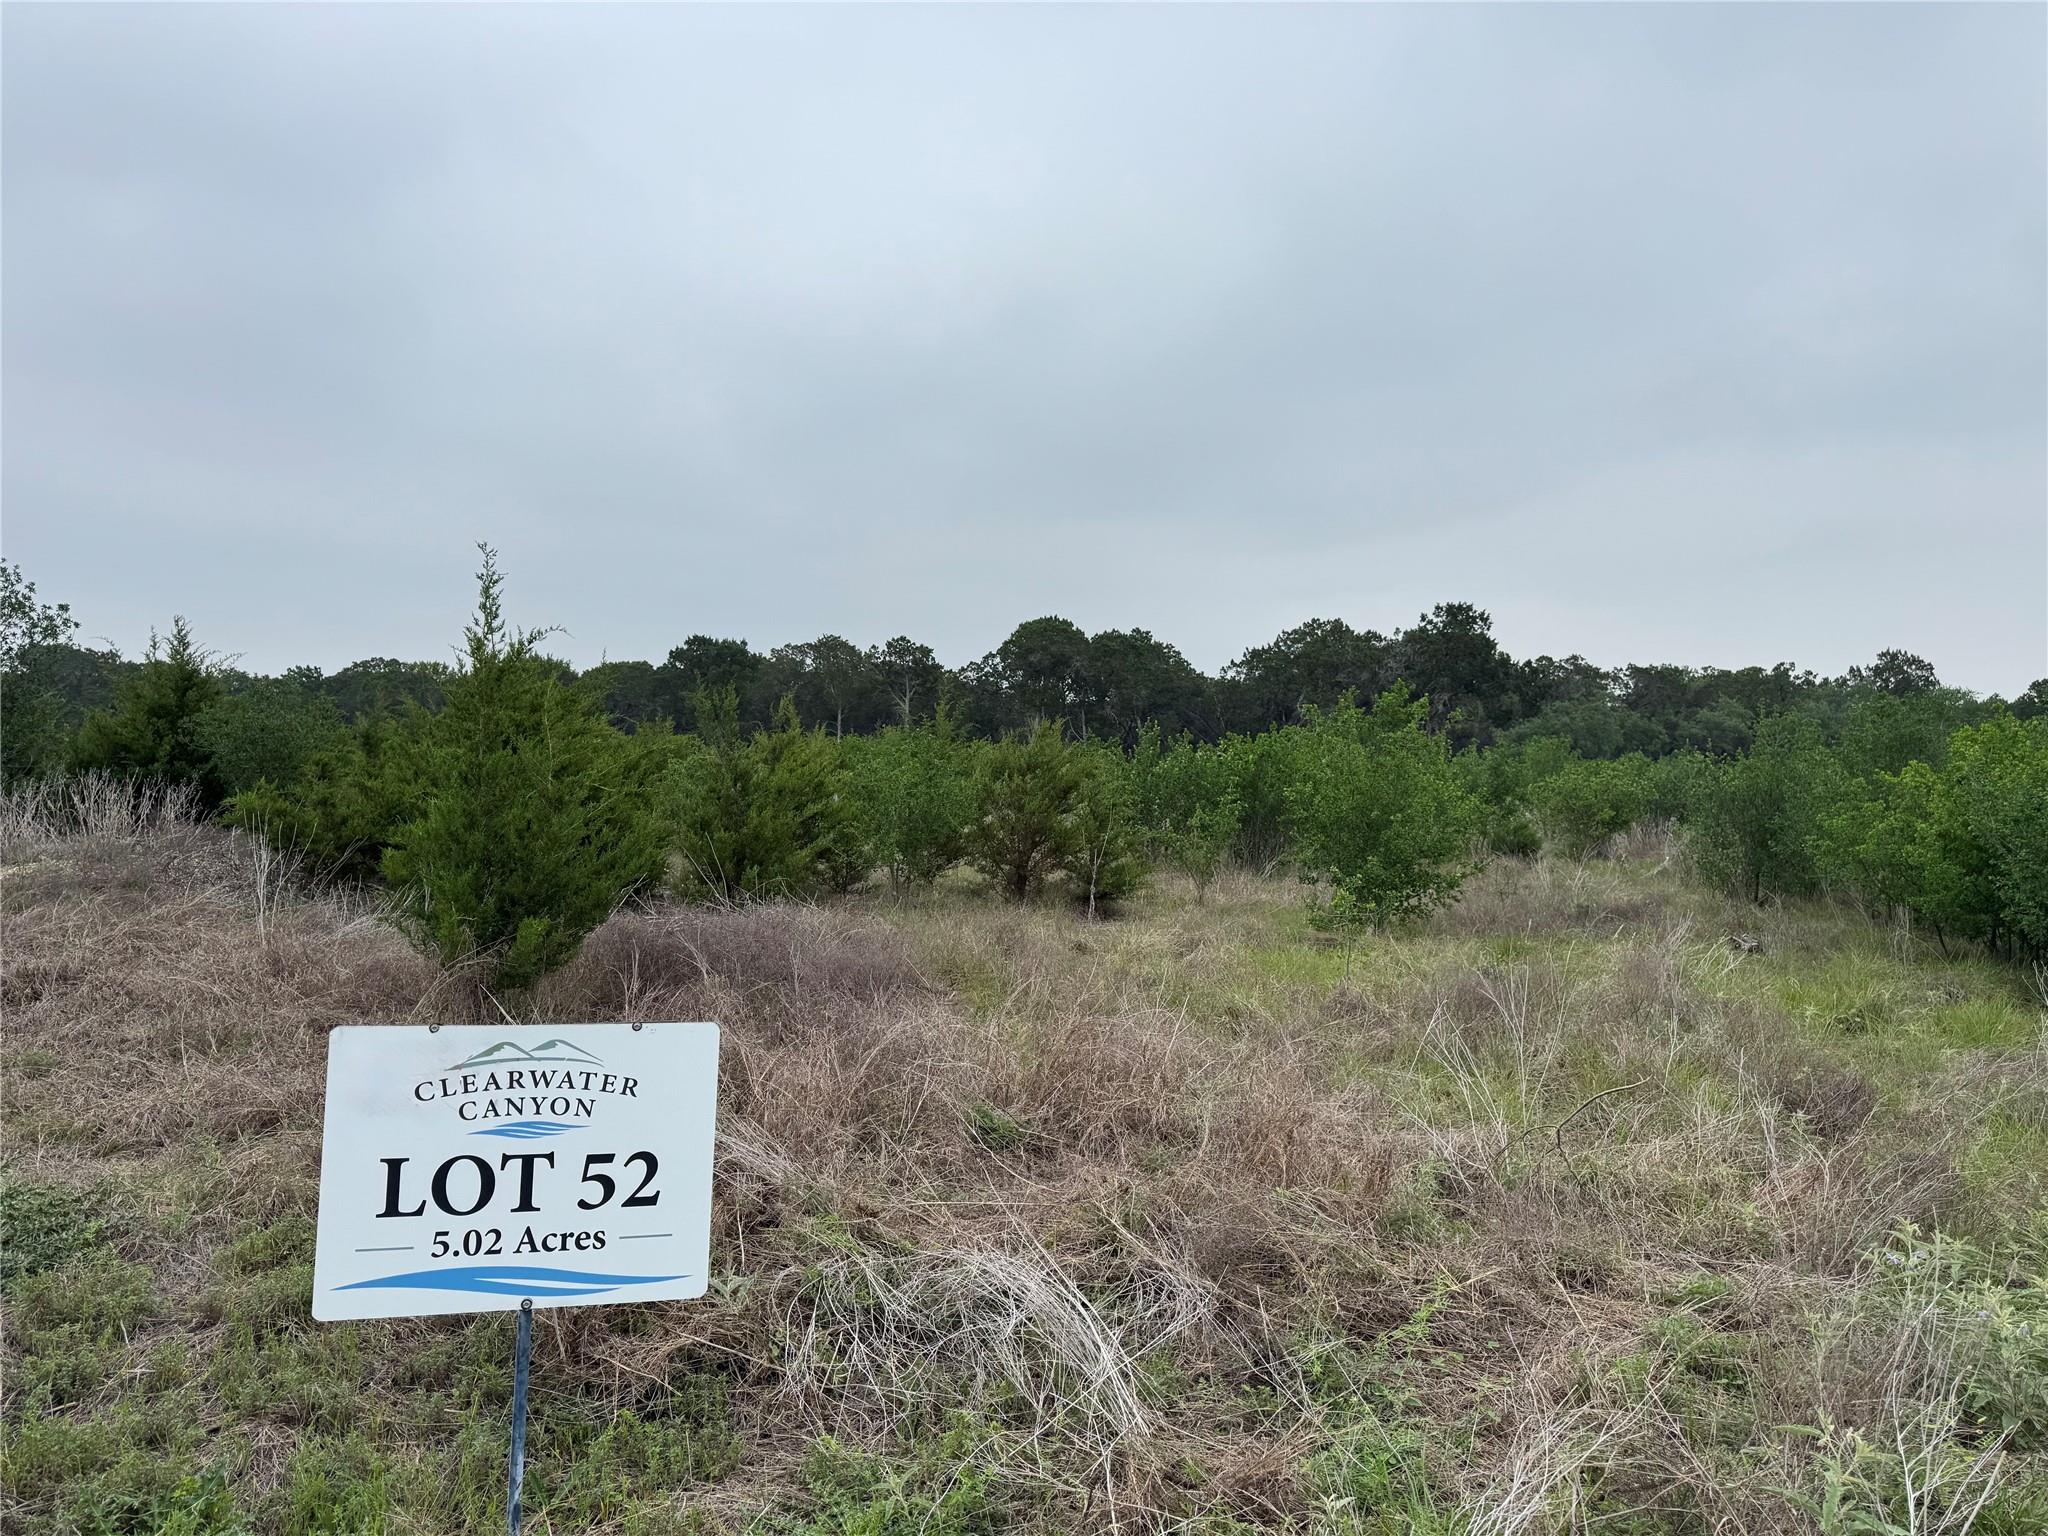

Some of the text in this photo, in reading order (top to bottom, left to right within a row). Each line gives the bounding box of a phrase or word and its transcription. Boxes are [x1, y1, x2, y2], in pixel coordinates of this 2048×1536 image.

[414, 1070, 639, 1102] CLEARWATER
[458, 1096, 596, 1121] CANYON
[375, 1151, 661, 1218] LOT 52
[431, 1226, 607, 1258] 5.02 Acres
